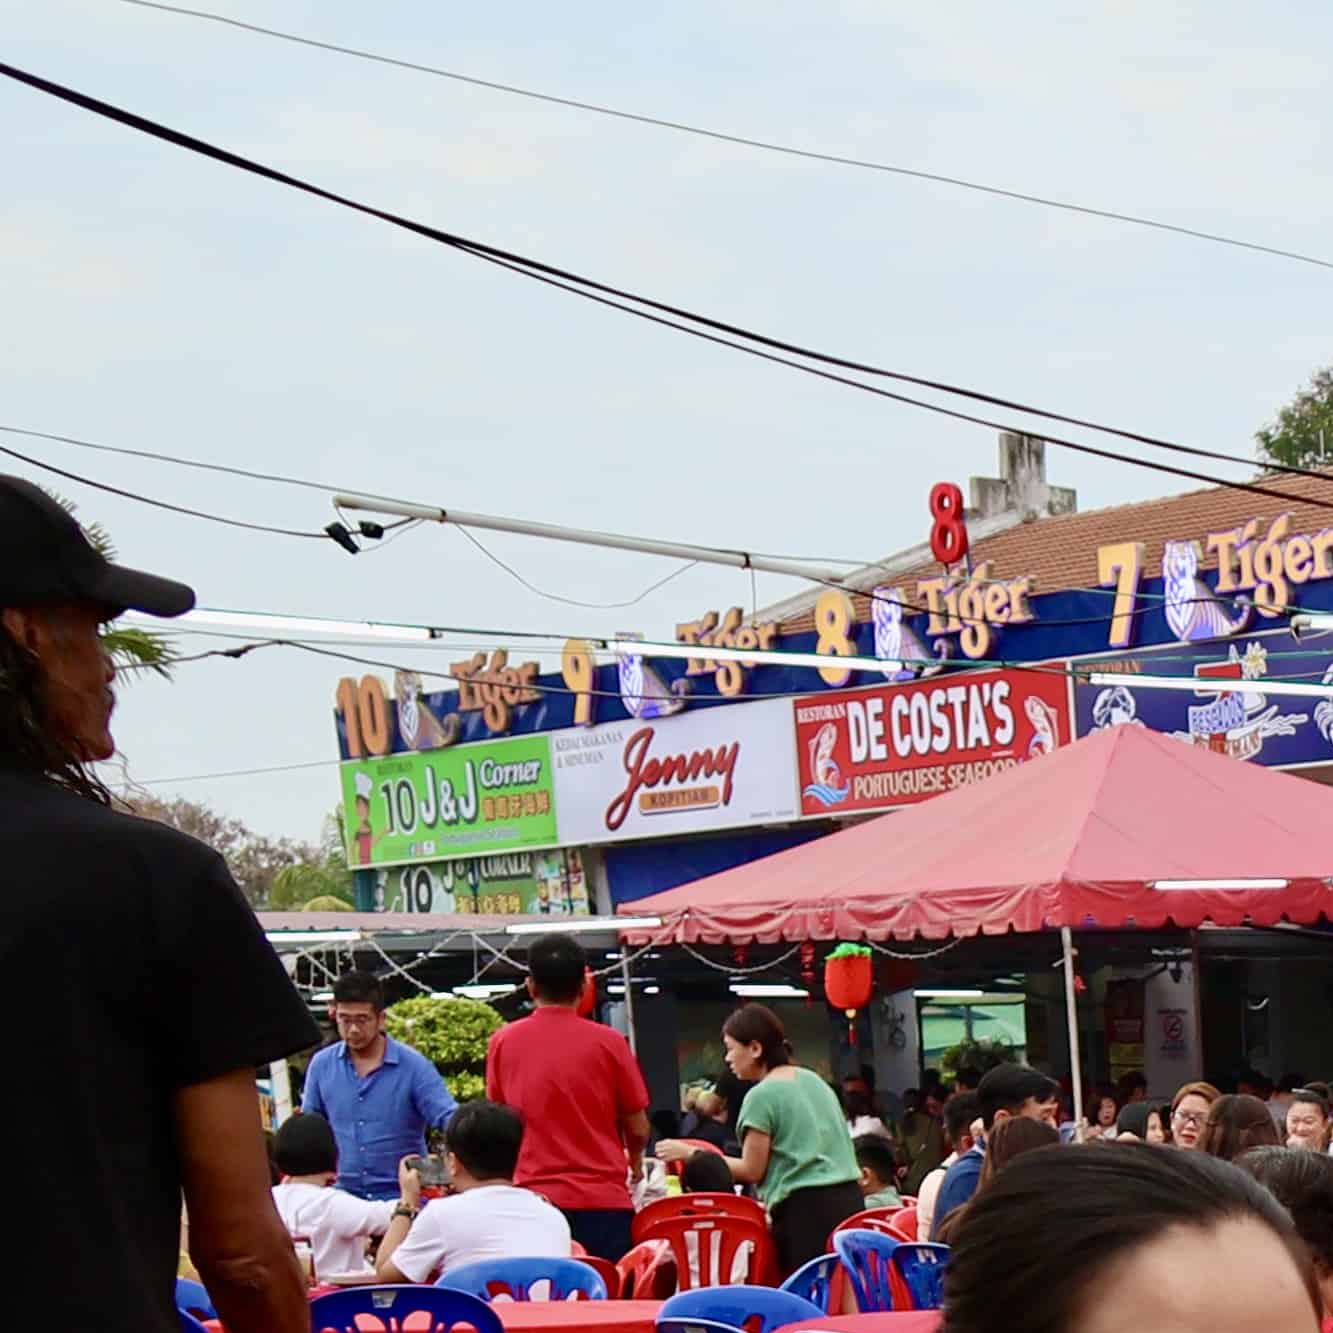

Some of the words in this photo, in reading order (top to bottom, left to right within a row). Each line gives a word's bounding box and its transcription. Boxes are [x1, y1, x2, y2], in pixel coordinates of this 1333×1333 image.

[930, 481, 969, 565] 8
[916, 561, 1035, 660] Tiger
[1098, 542, 1145, 648] 7
[676, 607, 782, 696] Tiger
[815, 589, 858, 687] 8
[337, 674, 391, 758] 10
[450, 649, 543, 732] Tiger
[561, 639, 600, 725] 9
[847, 698, 888, 763] DE
[890, 680, 1015, 757] COSTA'S
[381, 777, 416, 837] 10
[421, 761, 479, 829] J&J
[480, 758, 541, 790] Corner
[605, 727, 740, 831] Jenny
[854, 765, 947, 800] PORTUGUESE
